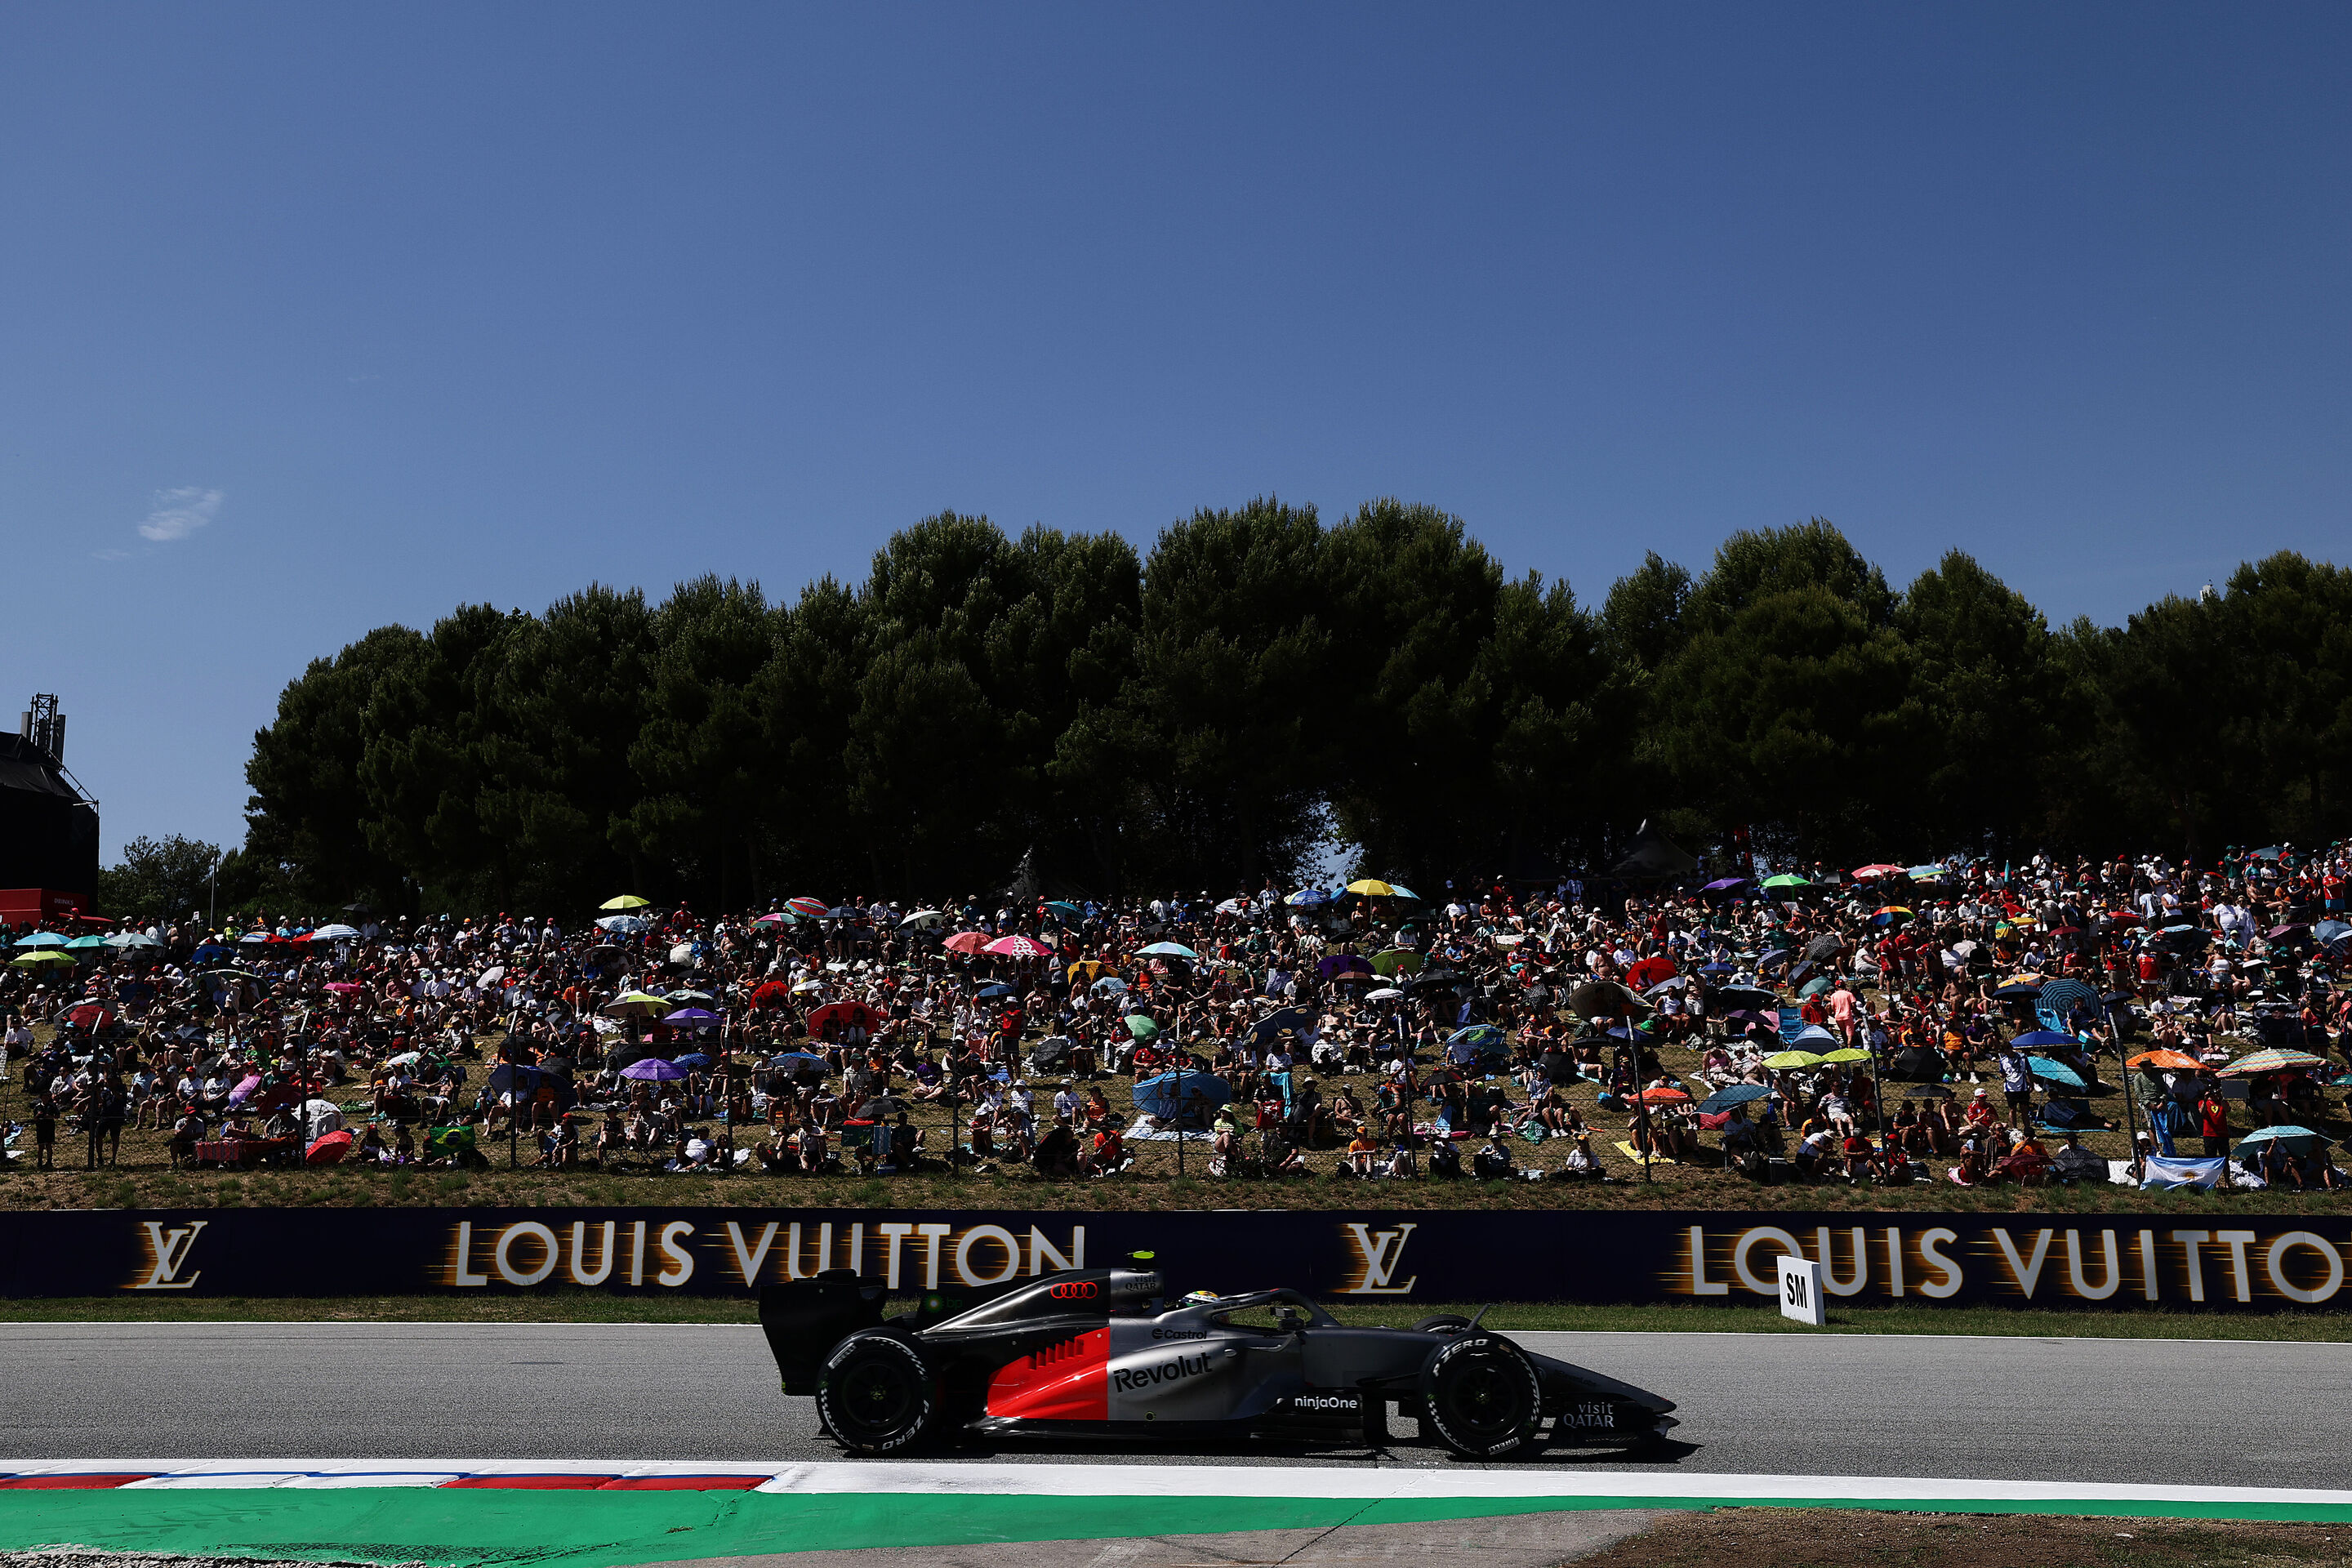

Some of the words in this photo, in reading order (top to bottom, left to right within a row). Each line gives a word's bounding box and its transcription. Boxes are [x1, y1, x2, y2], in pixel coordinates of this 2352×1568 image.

[54, 898, 74, 906] DRINKS
[455, 1221, 696, 1288] LOUIS
[726, 1221, 1085, 1290] VUITTON
[1690, 1226, 1963, 1298] LOUIS
[1991, 1227, 2352, 1303] VUITTO
[1134, 1275, 1156, 1283] visit
[1125, 1282, 1156, 1291] QATAR
[1785, 1272, 1808, 1309] SM
[947, 1296, 963, 1310] bp
[1164, 1330, 1207, 1340] Castrol
[1432, 1363, 1440, 1377] P
[1441, 1339, 1489, 1364] ZERO
[1113, 1352, 1213, 1393] Revolut
[923, 1399, 929, 1414] P
[1294, 1396, 1358, 1410] ninjaOne
[1578, 1401, 1614, 1414] visit
[1563, 1414, 1615, 1428] QATAR
[881, 1414, 924, 1450] ZERO
